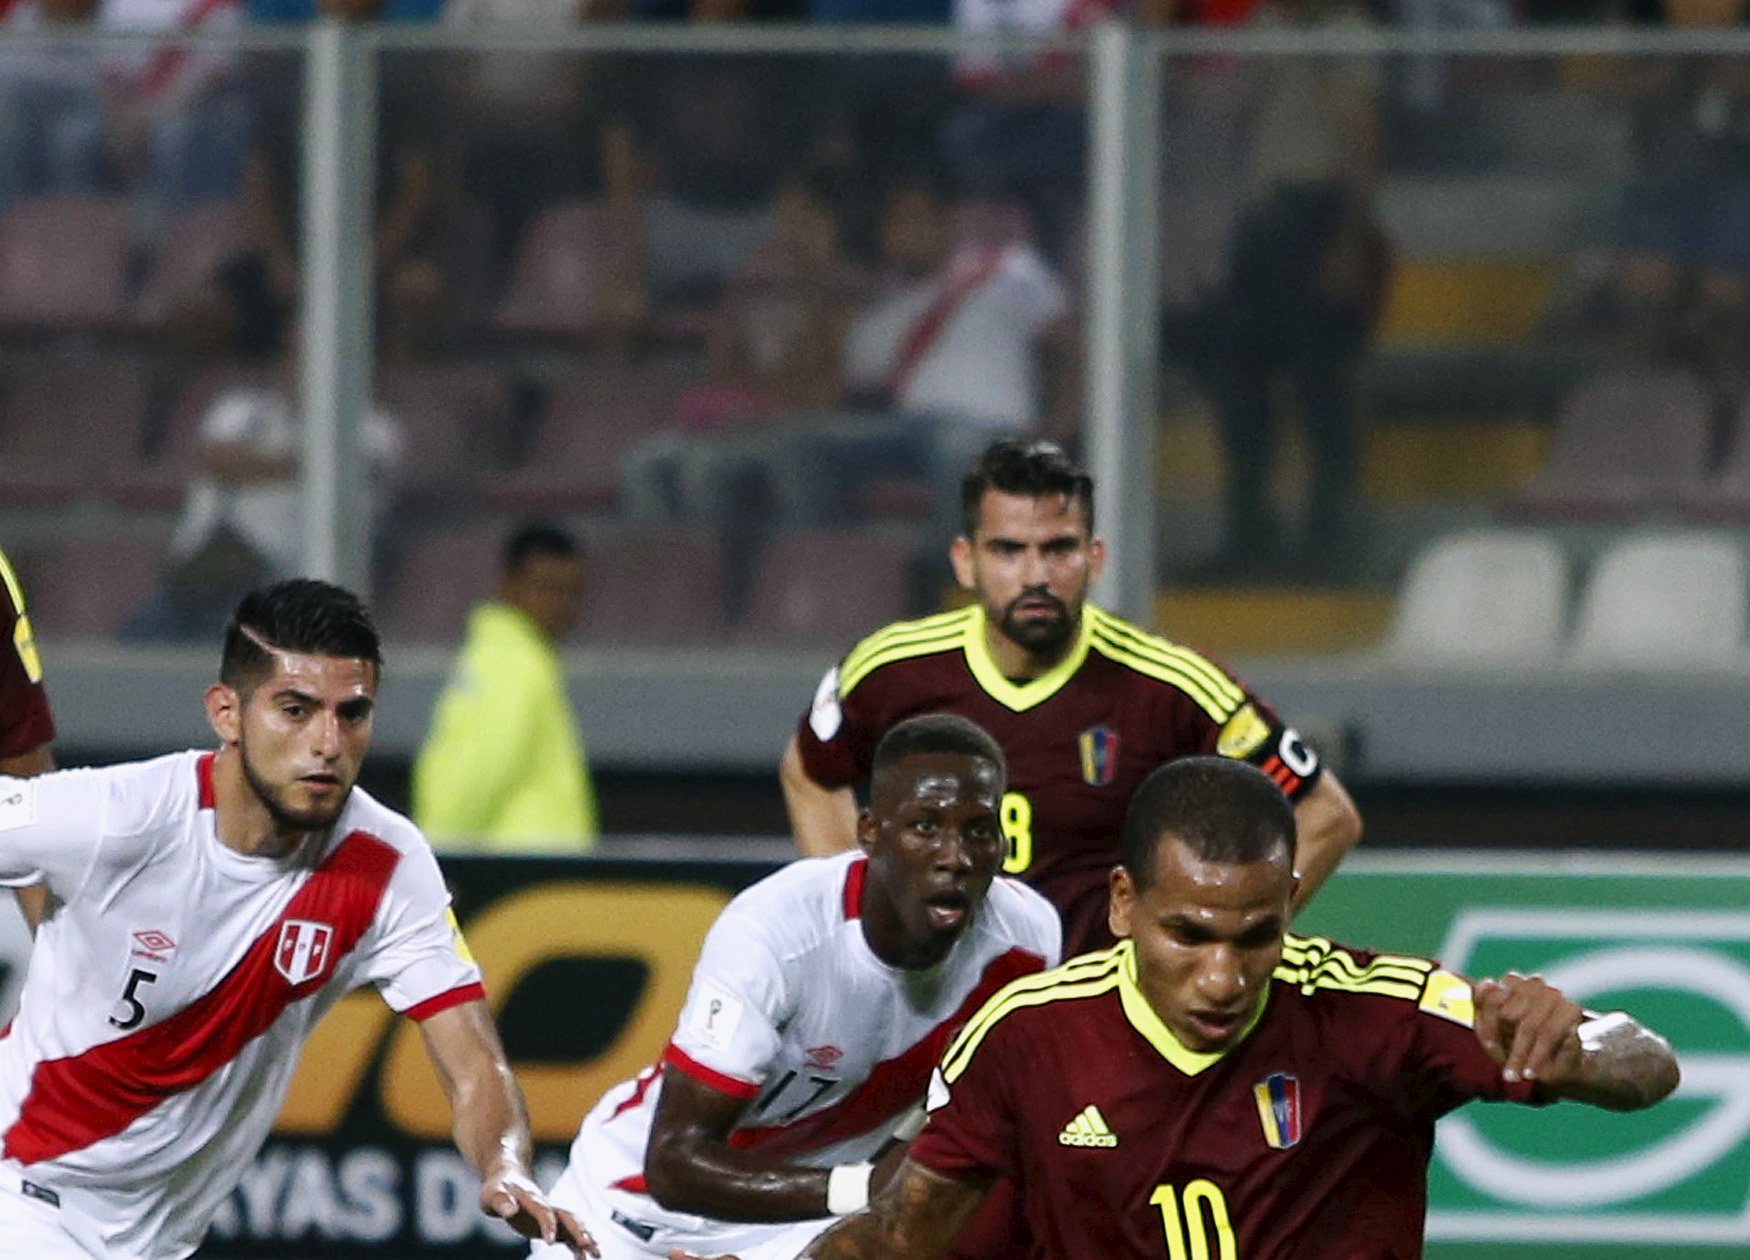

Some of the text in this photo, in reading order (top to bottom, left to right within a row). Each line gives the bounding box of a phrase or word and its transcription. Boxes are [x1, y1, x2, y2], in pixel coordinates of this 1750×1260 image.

[1000, 792, 1032, 874] 8
[108, 968, 158, 1031] 5
[755, 1070, 840, 1121] 17
